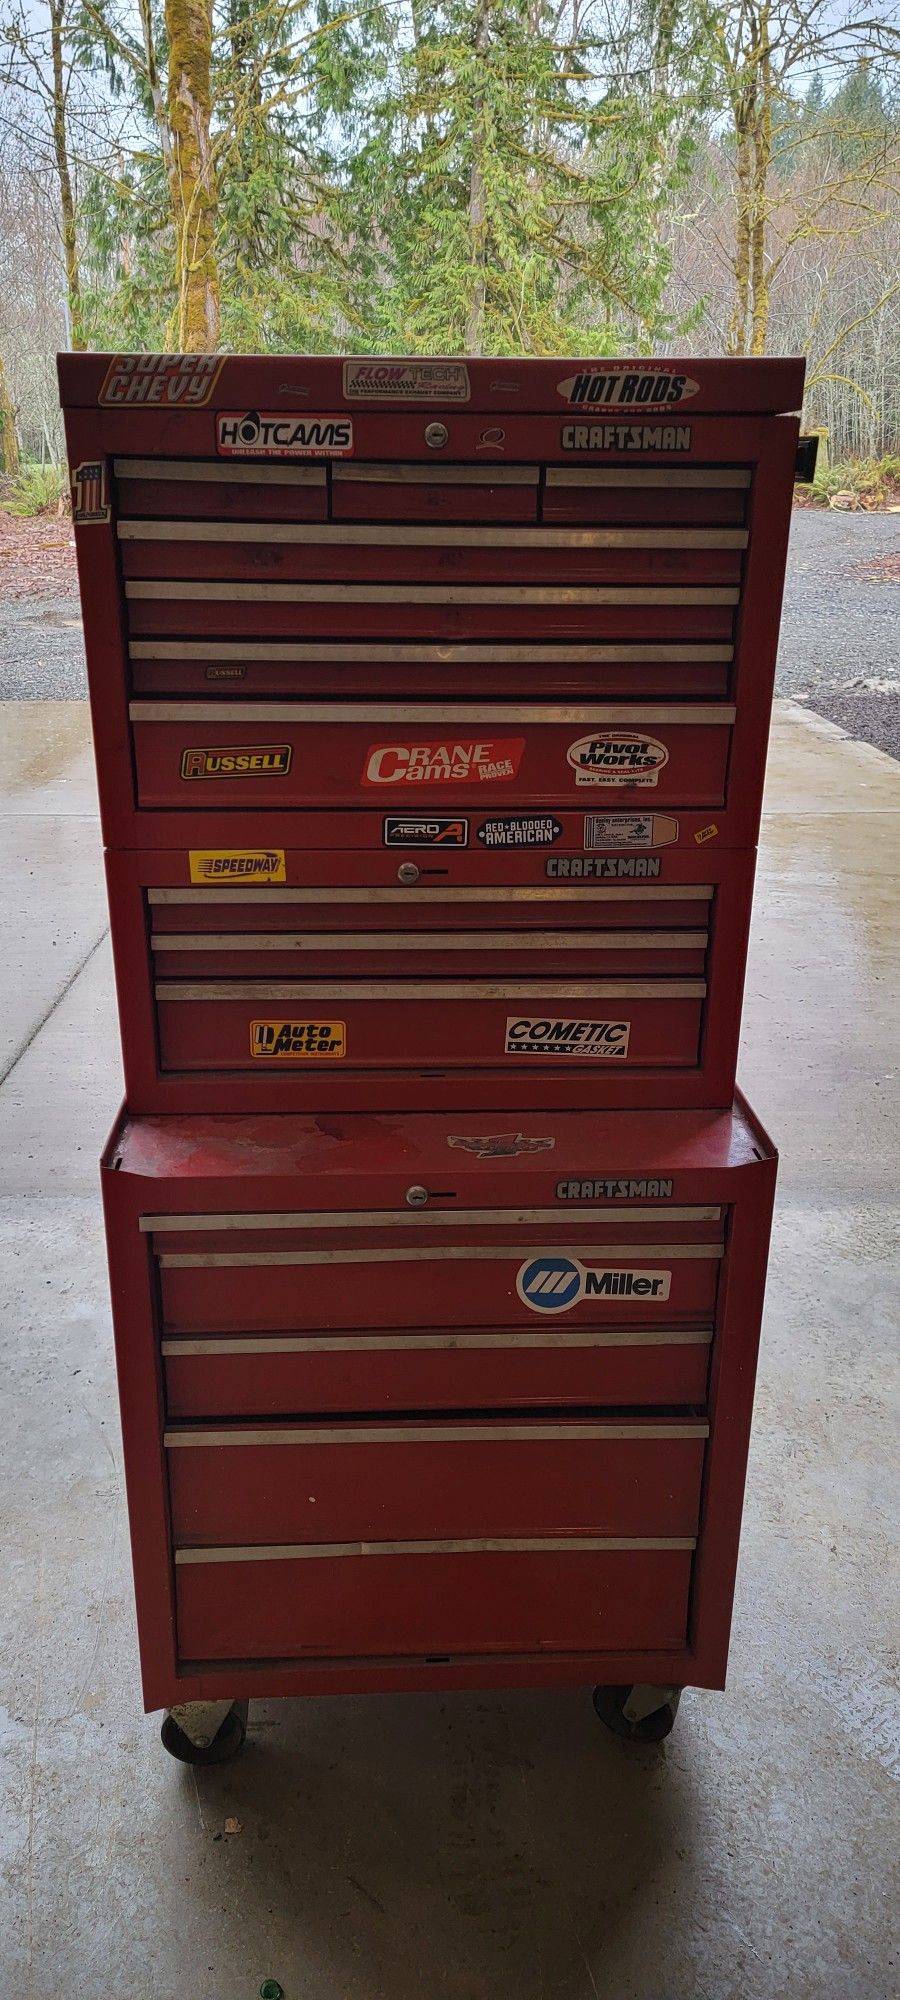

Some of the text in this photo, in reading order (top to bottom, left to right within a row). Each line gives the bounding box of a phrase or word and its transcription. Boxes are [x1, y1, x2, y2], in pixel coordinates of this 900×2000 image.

[355, 367, 459, 381] FLOW TECH
[105, 375, 212, 402] CHEVY
[569, 374, 687, 403] HOT RODS
[221, 417, 351, 447] HOTCAMS
[561, 425, 691, 450] CRAFTSMAN
[314, 449, 343, 457] WITHIN
[589, 742, 650, 754] Pivot
[186, 752, 285, 775] RUSSELL
[367, 744, 494, 783] CRANE
[580, 753, 658, 766] Works
[390, 824, 440, 833] AERO
[486, 819, 553, 832] RED BLOODED
[485, 828, 553, 845] AMERICAN
[212, 858, 280, 873] SPEEDWAY
[546, 858, 660, 877] CRAFTSMAN
[277, 1024, 332, 1038] Auto
[508, 1020, 628, 1042] COMETIC
[273, 1038, 342, 1053] Meter
[572, 1044, 623, 1055] GASKET
[556, 1179, 673, 1199] CRAFTSMAN
[585, 1272, 664, 1295] Miller
